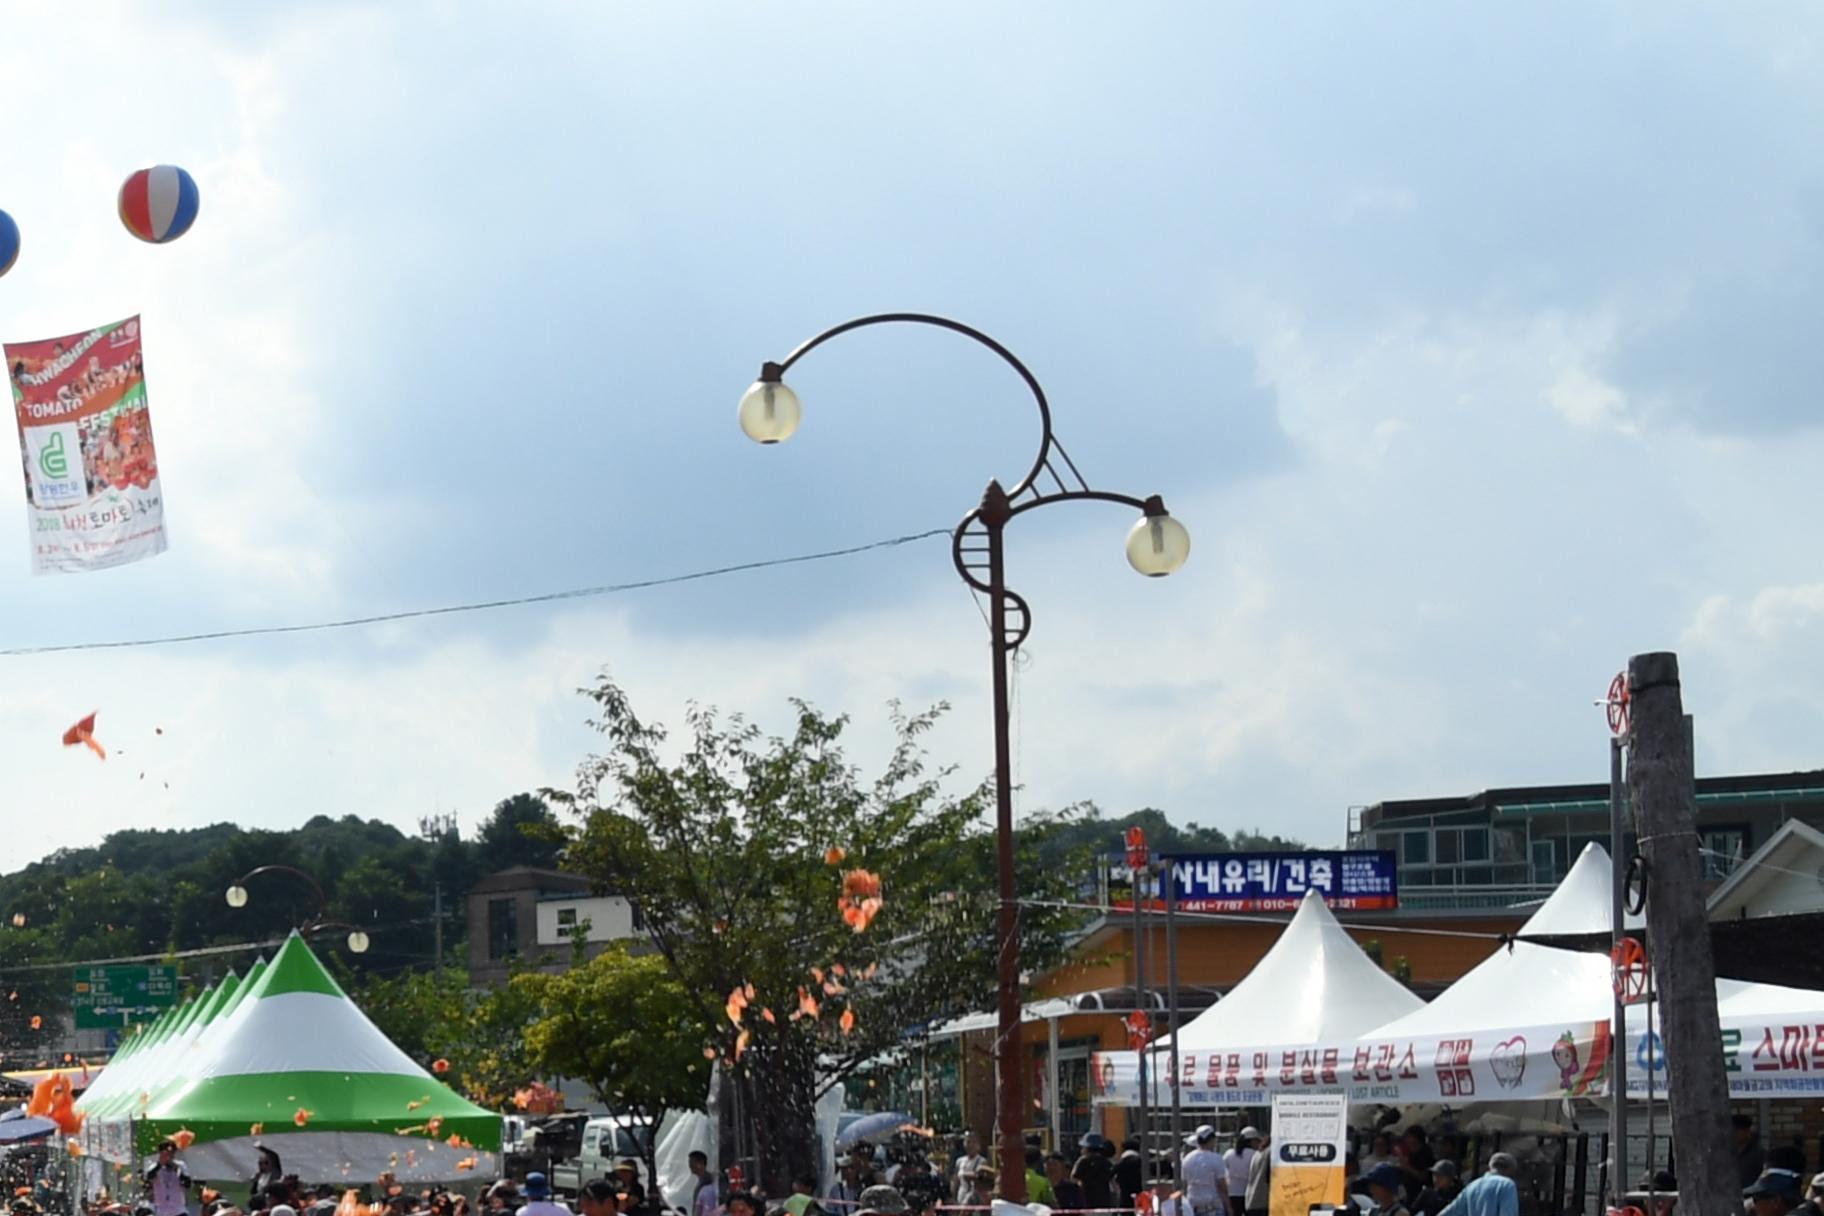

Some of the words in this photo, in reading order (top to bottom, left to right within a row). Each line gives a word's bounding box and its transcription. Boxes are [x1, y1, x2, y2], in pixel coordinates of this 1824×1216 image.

[29, 329, 104, 387] HWACHEON
[26, 399, 84, 419] TOMATO
[89, 506, 132, 529] 토마토
[1205, 1054, 1241, 1088] 물품
[1252, 1052, 1268, 1087] 및
[1279, 1048, 1340, 1086] 분실물
[1352, 1042, 1419, 1082] 보관소
[1351, 1087, 1370, 1100] LOST
[1370, 1086, 1400, 1099] ARTICLE
[1288, 1144, 1329, 1158] 무료사용
